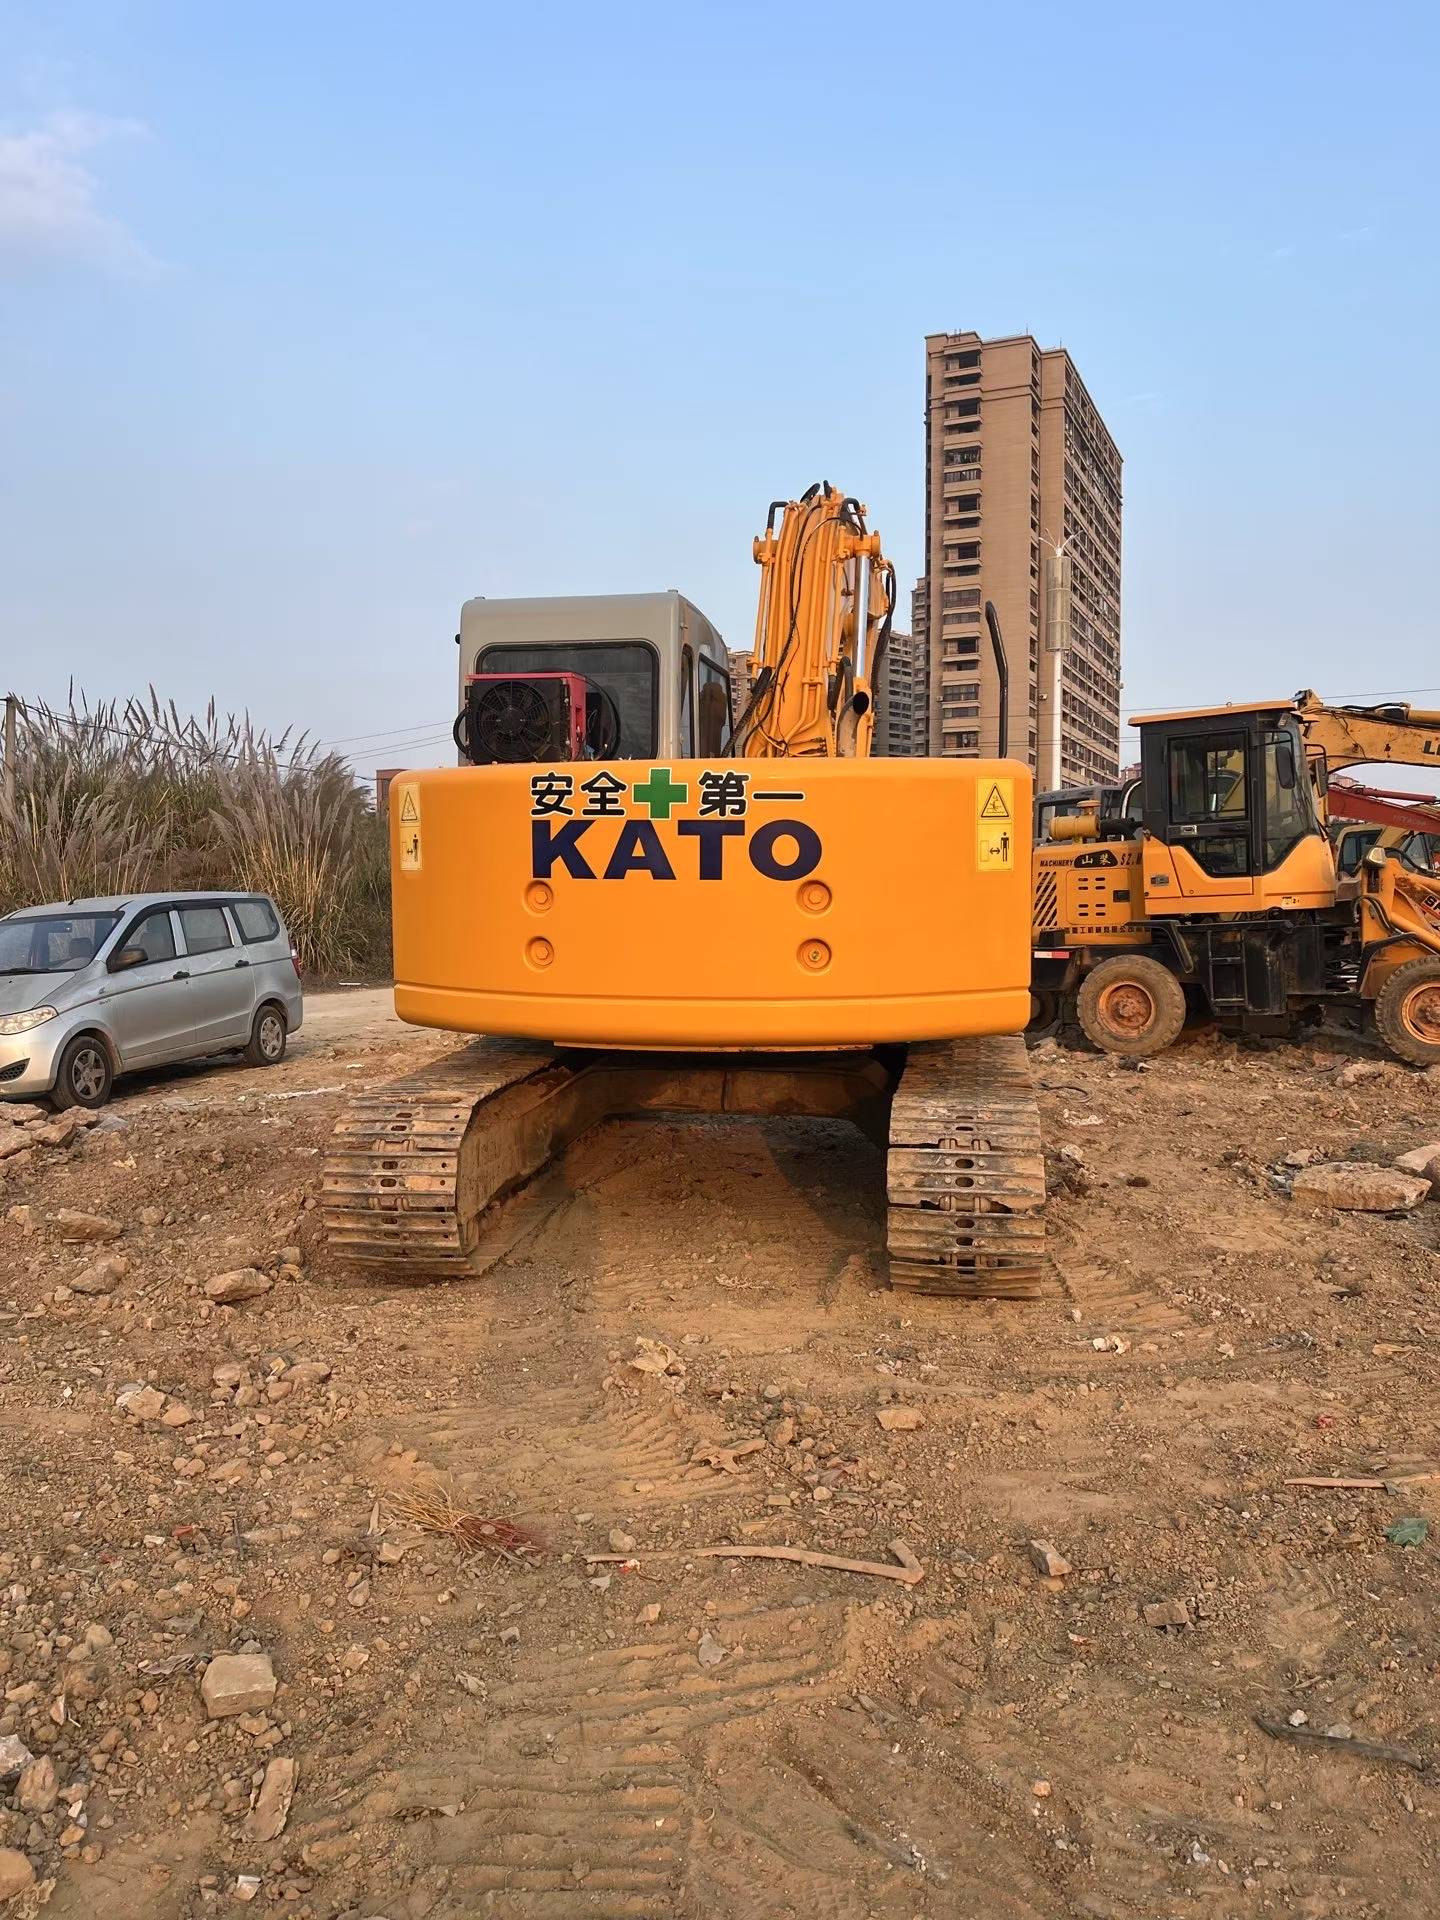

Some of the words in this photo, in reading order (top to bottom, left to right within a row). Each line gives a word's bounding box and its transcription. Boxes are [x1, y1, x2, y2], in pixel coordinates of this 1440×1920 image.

[531, 771, 627, 817] 安全
[698, 770, 805, 818] 第一
[532, 819, 823, 881] KATO
[1040, 859, 1073, 867] MACHINERY
